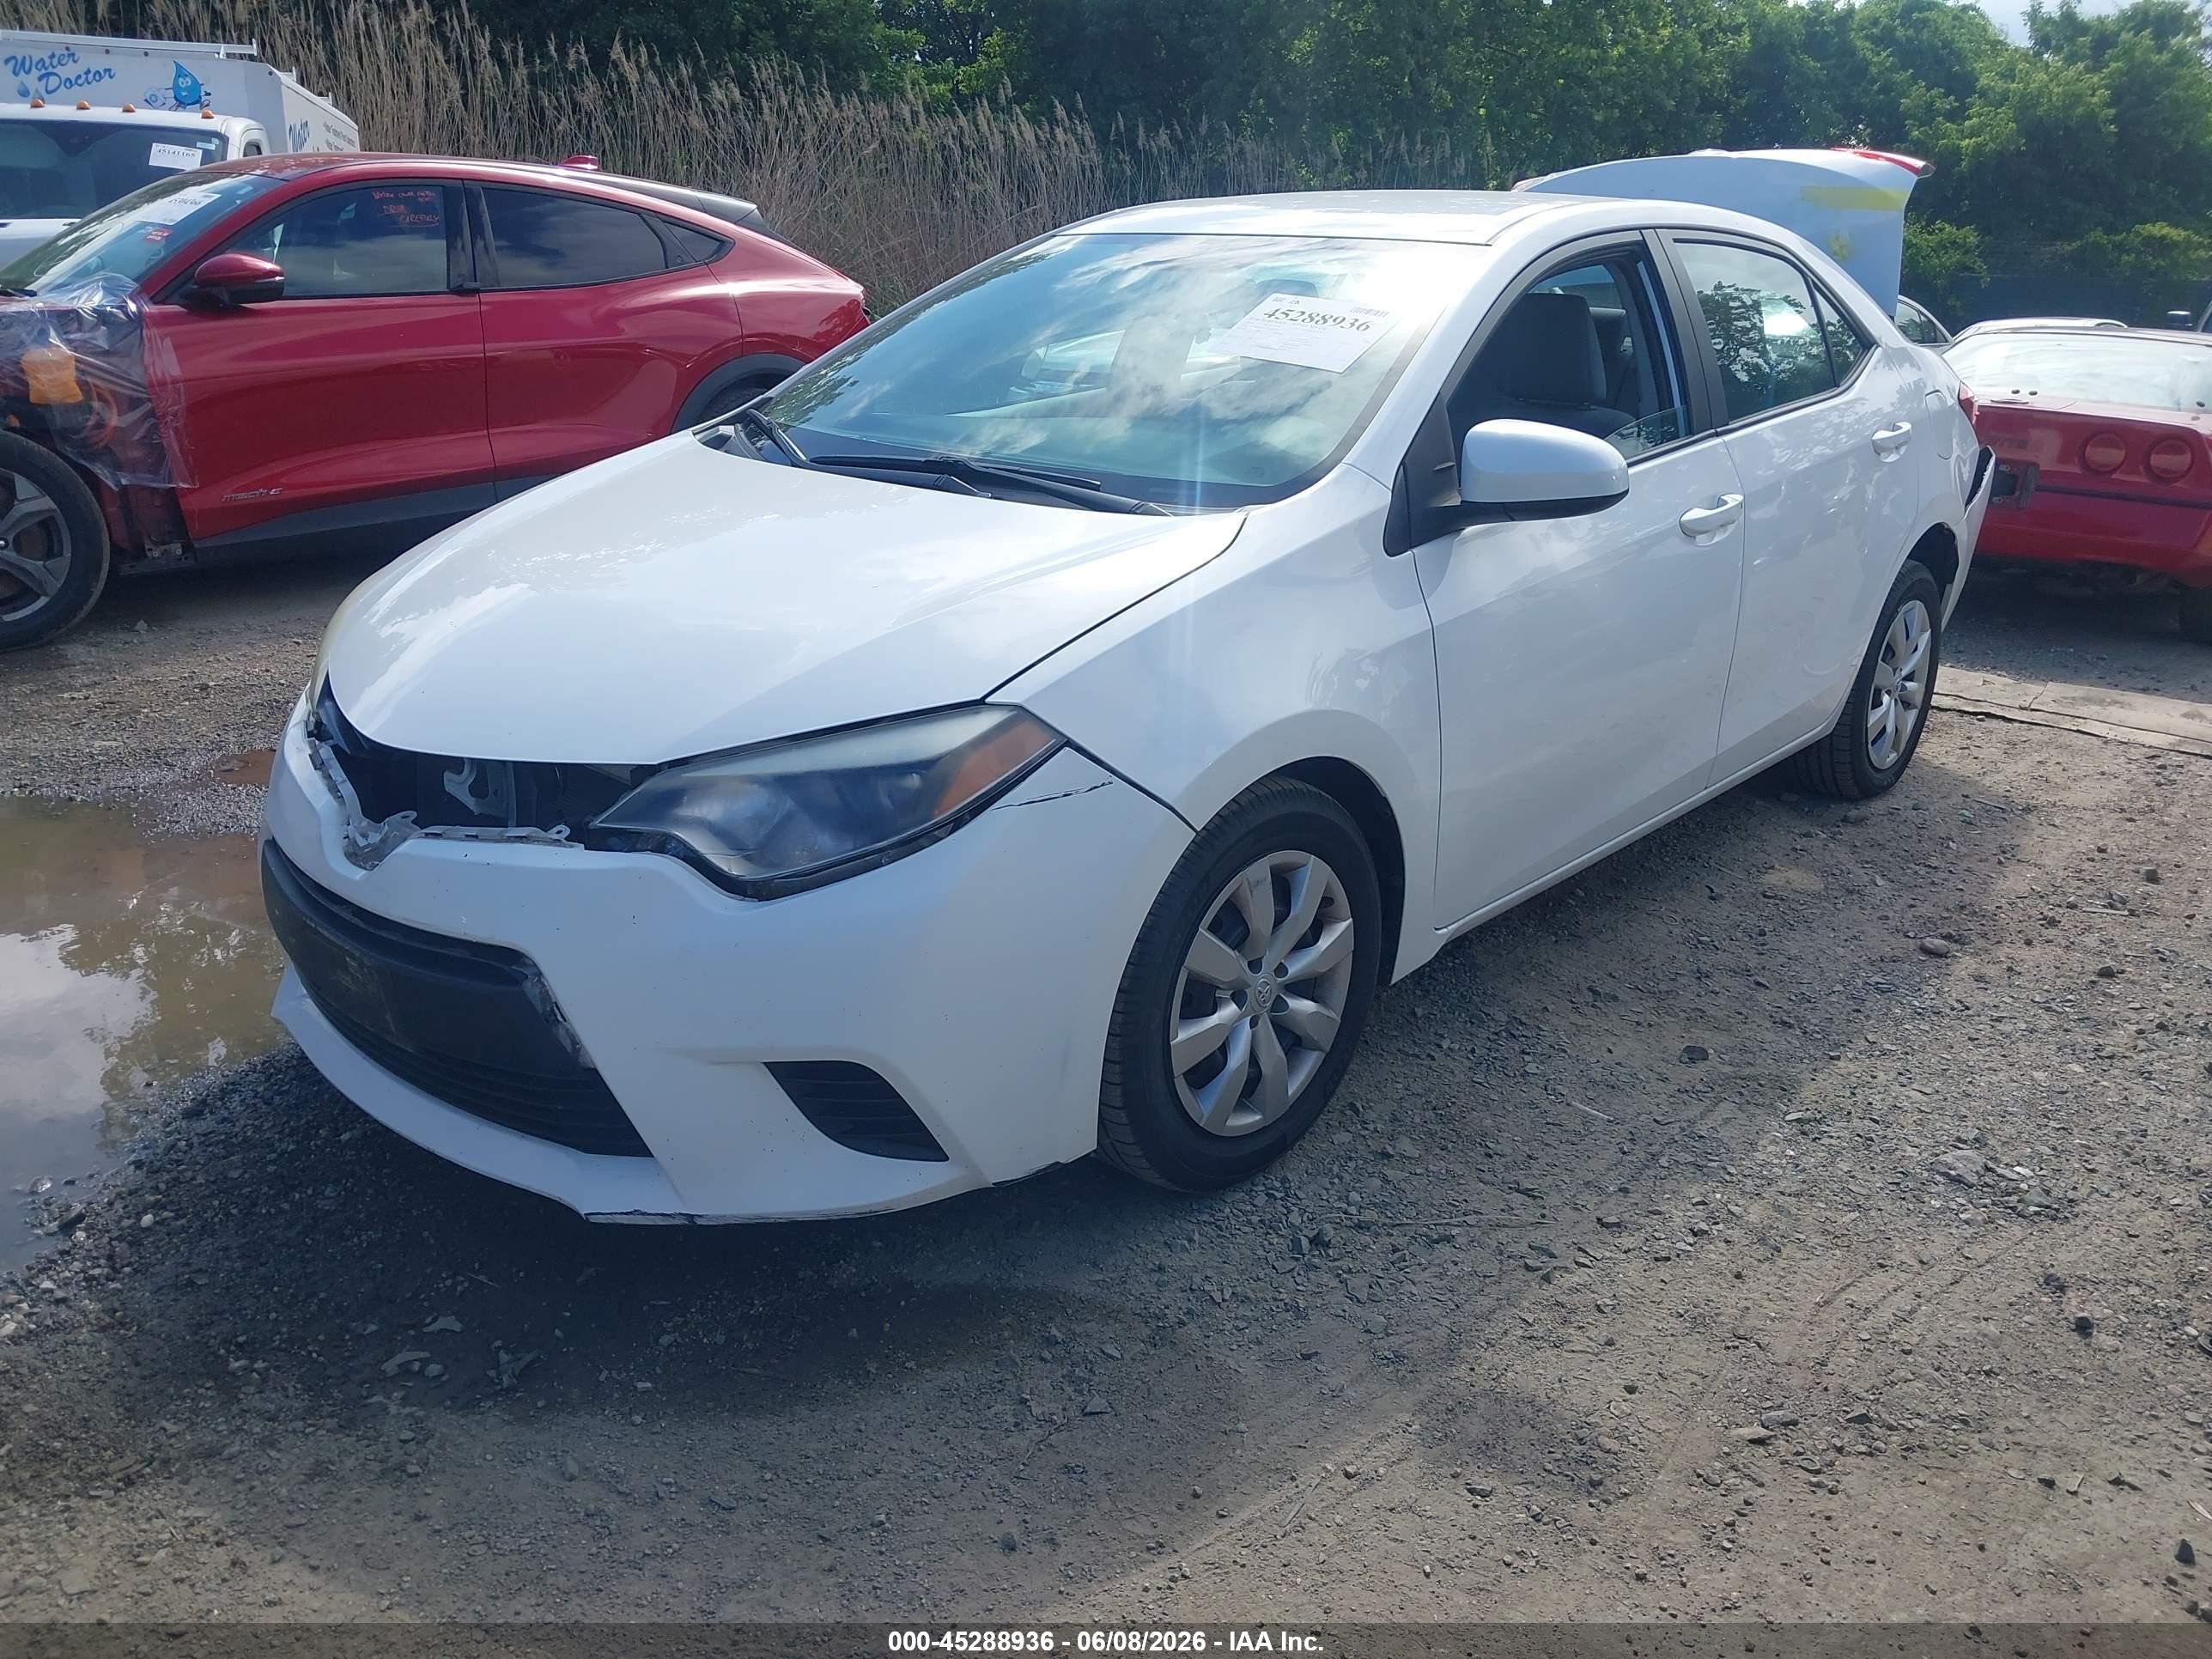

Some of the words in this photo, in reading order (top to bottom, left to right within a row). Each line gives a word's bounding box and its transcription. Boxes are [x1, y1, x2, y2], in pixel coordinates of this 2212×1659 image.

[3, 51, 80, 77] Water
[38, 67, 116, 94] Doctor
[289, 118, 310, 152] Water
[1263, 307, 1374, 332] 45288936
